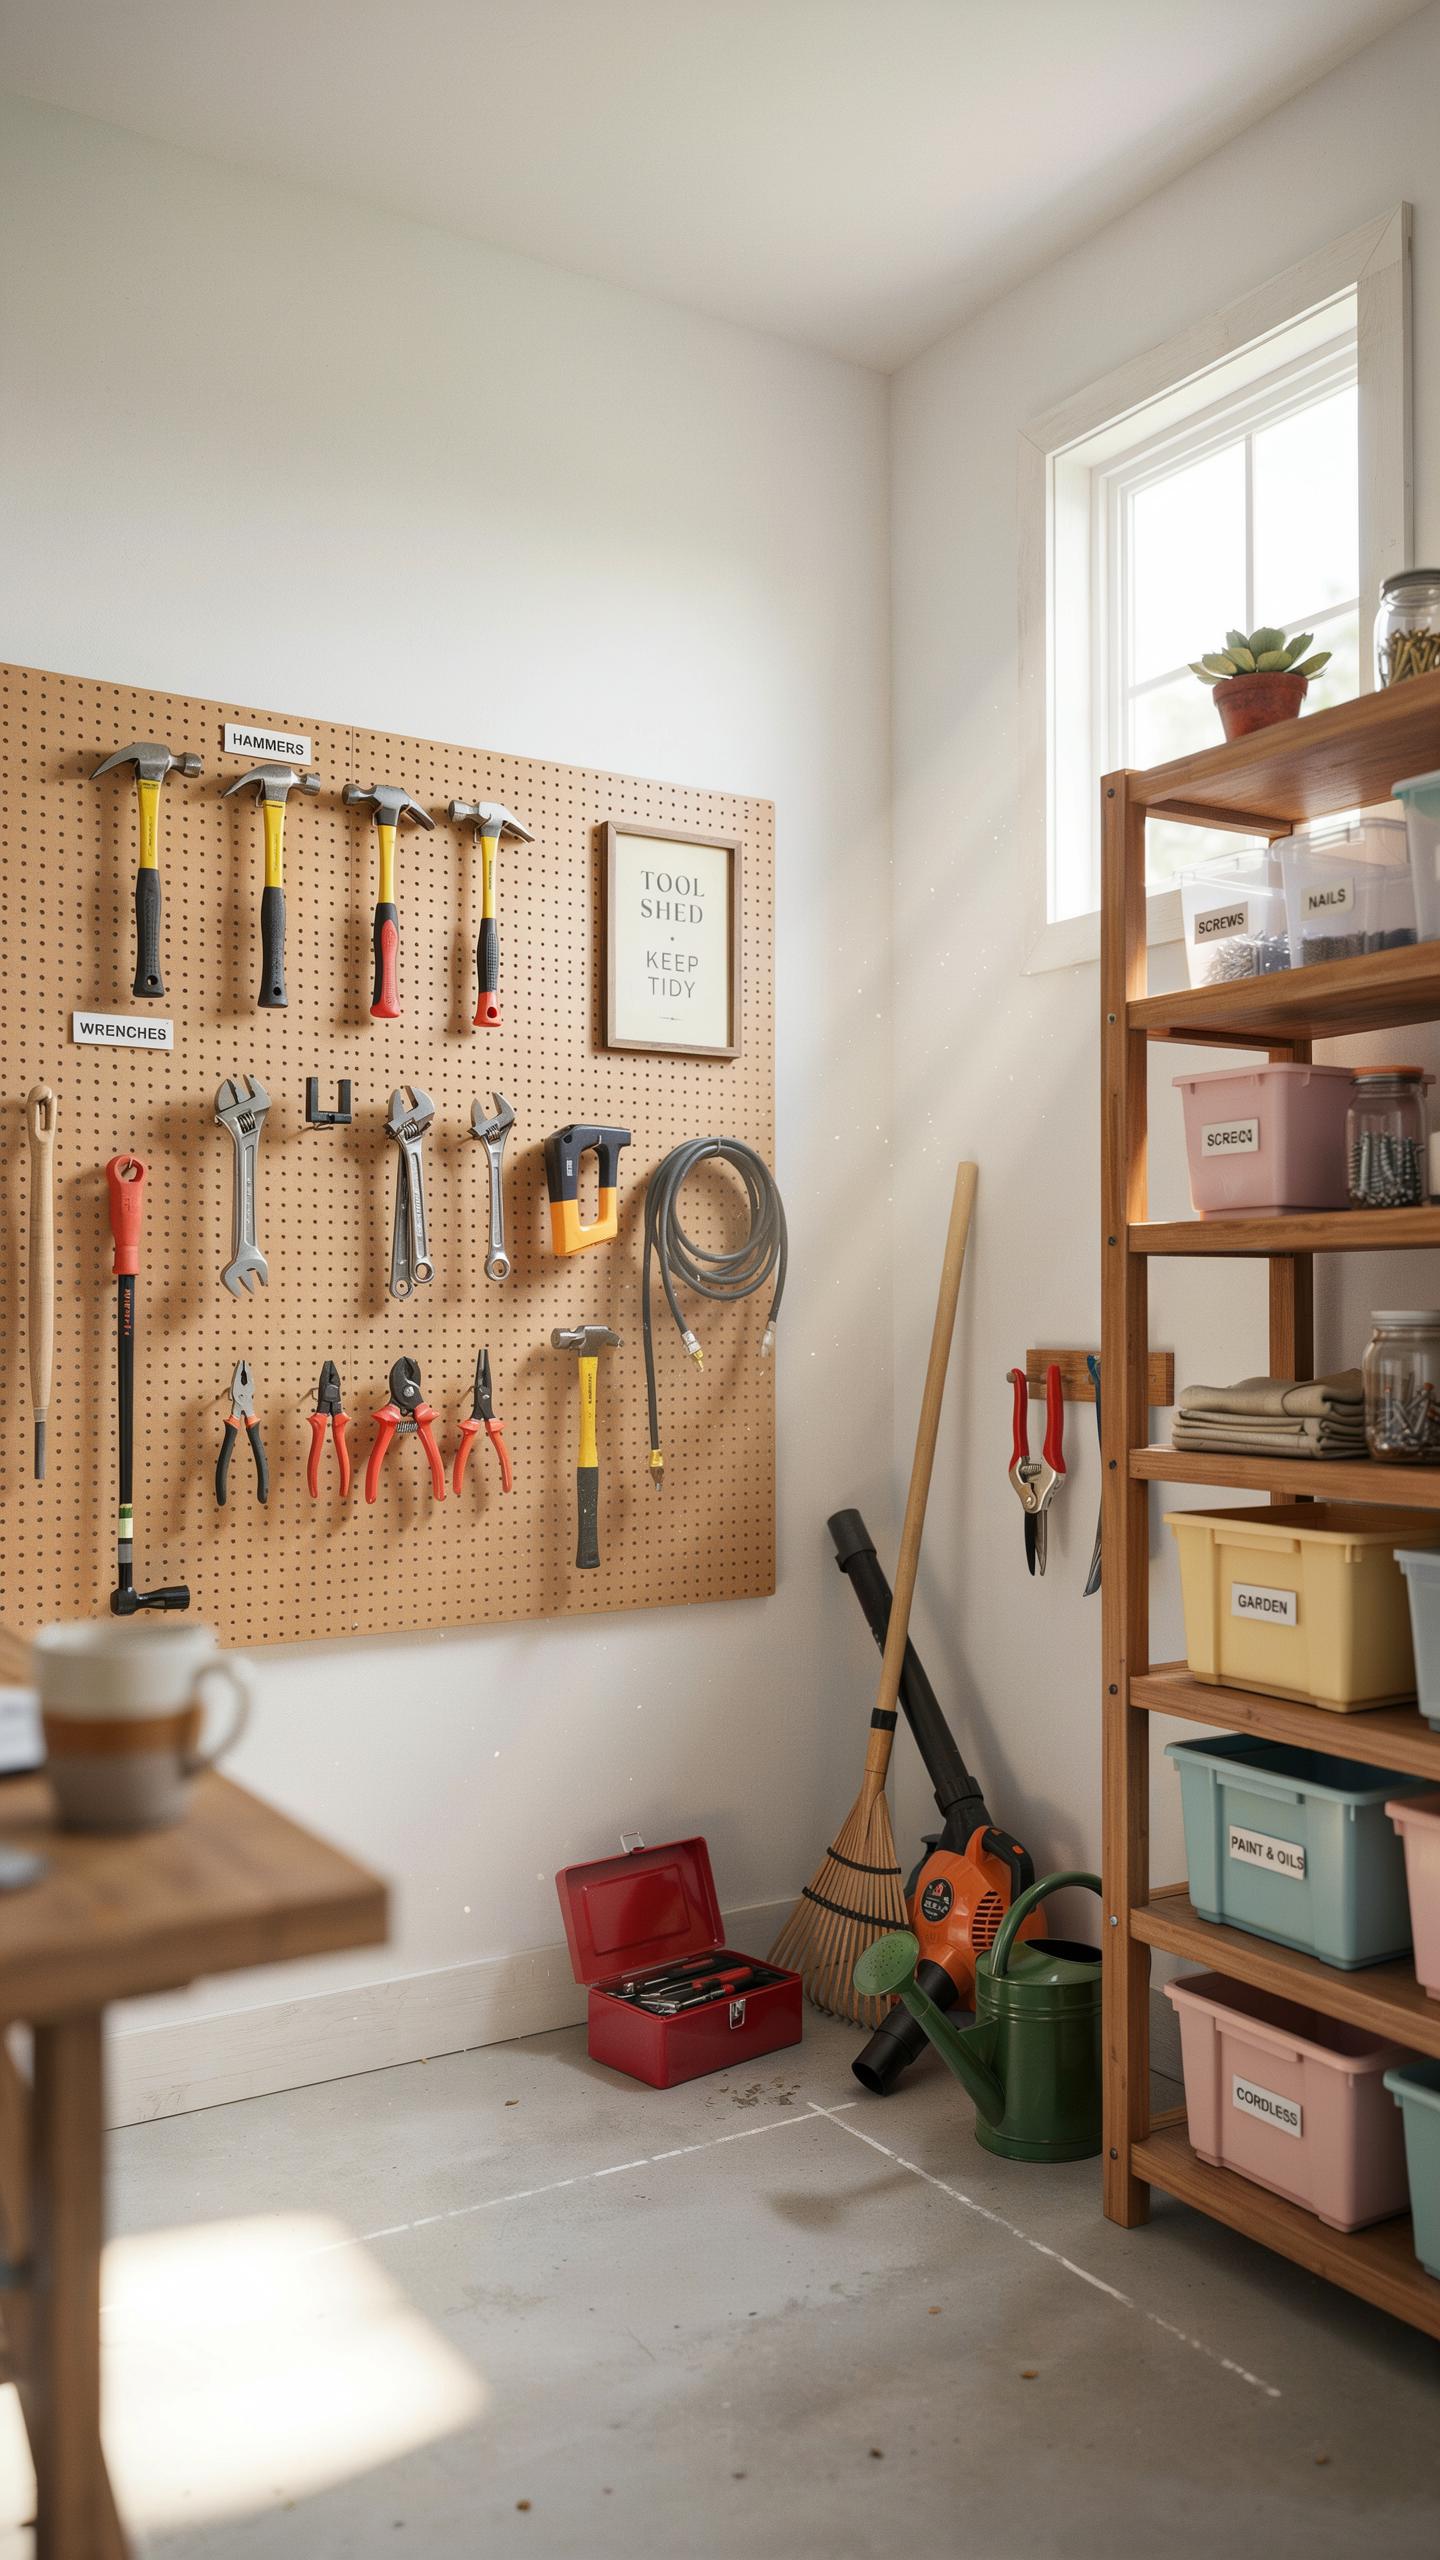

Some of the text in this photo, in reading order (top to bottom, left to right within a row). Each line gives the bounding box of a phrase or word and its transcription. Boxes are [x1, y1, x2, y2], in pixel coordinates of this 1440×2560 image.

[233, 733, 304, 755] HAMMERS
[640, 870, 705, 897] TOOL
[1308, 888, 1346, 910] NAILS
[640, 898, 703, 924] SHED
[1198, 912, 1244, 934] SCREWS
[646, 950, 699, 973] KEEP
[648, 976, 695, 998] TIDY
[80, 1022, 166, 1040] WRENCHES
[1238, 1594, 1287, 1615] GARDEN
[1231, 1836, 1304, 1870] PAINT & OILS
[1236, 2087, 1298, 2126] CORDLESS
